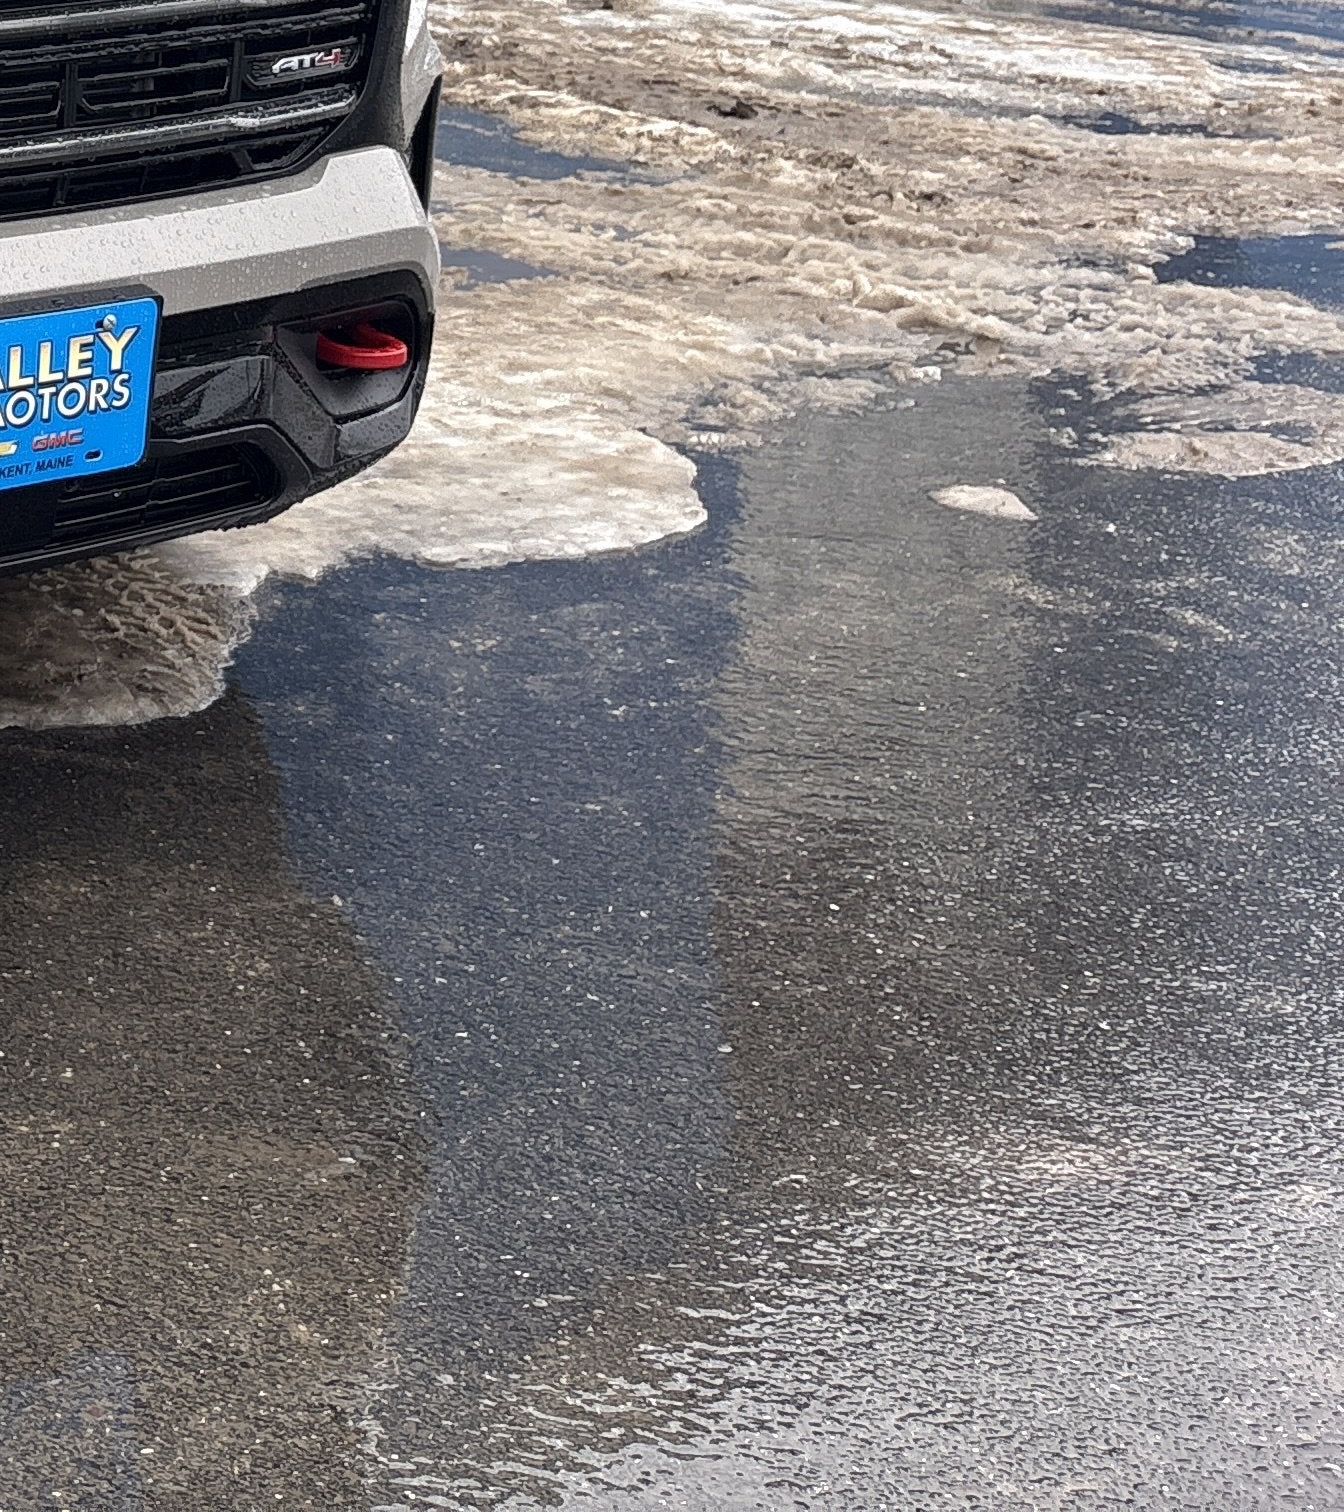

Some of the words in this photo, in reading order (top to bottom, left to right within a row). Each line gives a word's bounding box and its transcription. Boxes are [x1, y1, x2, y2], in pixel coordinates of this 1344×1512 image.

[272, 48, 342, 74] AT4
[31, 428, 85, 452] GMC
[35, 454, 74, 472] MAINE
